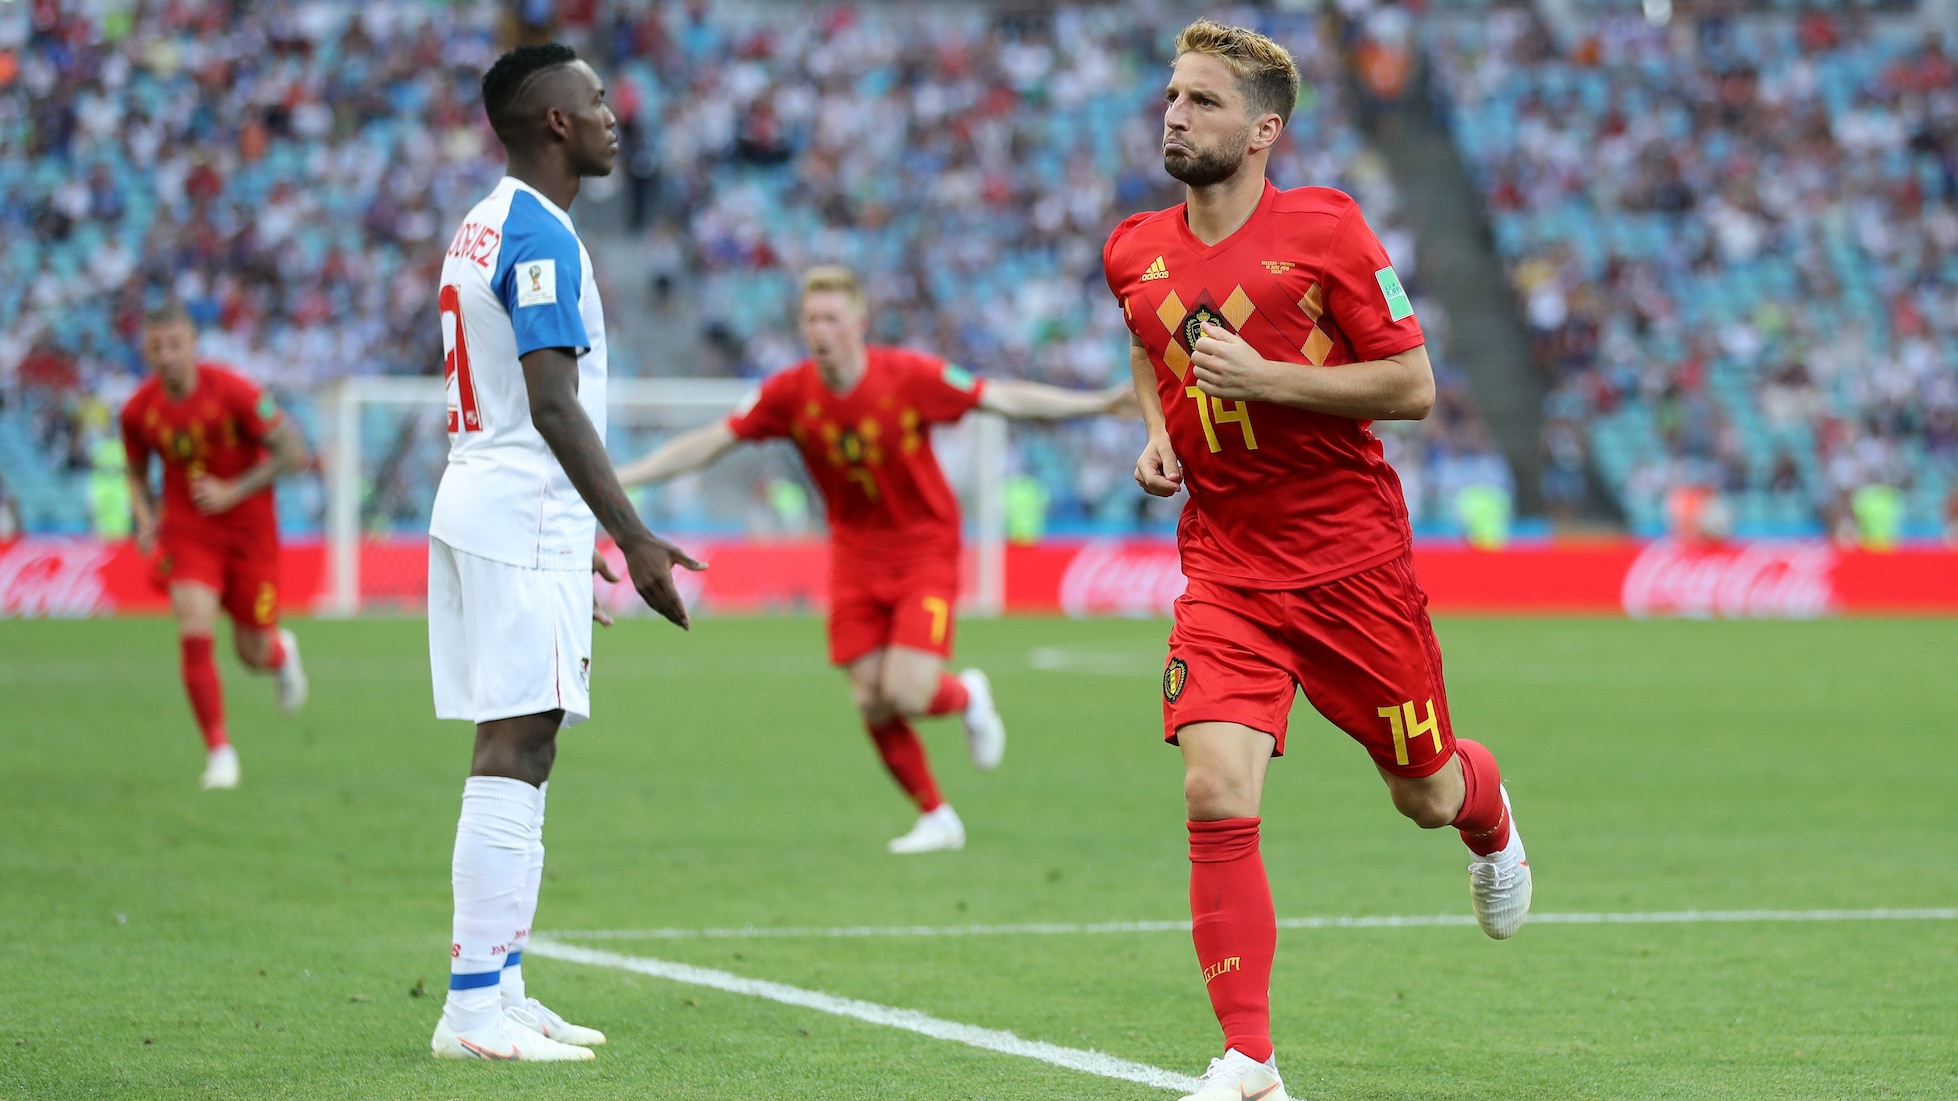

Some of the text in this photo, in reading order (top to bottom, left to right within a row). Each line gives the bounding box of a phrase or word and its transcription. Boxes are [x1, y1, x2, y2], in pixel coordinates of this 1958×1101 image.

[1141, 270, 1169, 281] adidas
[1185, 386, 1258, 453] 14
[920, 594, 950, 646] 7
[1377, 698, 1443, 766] 14
